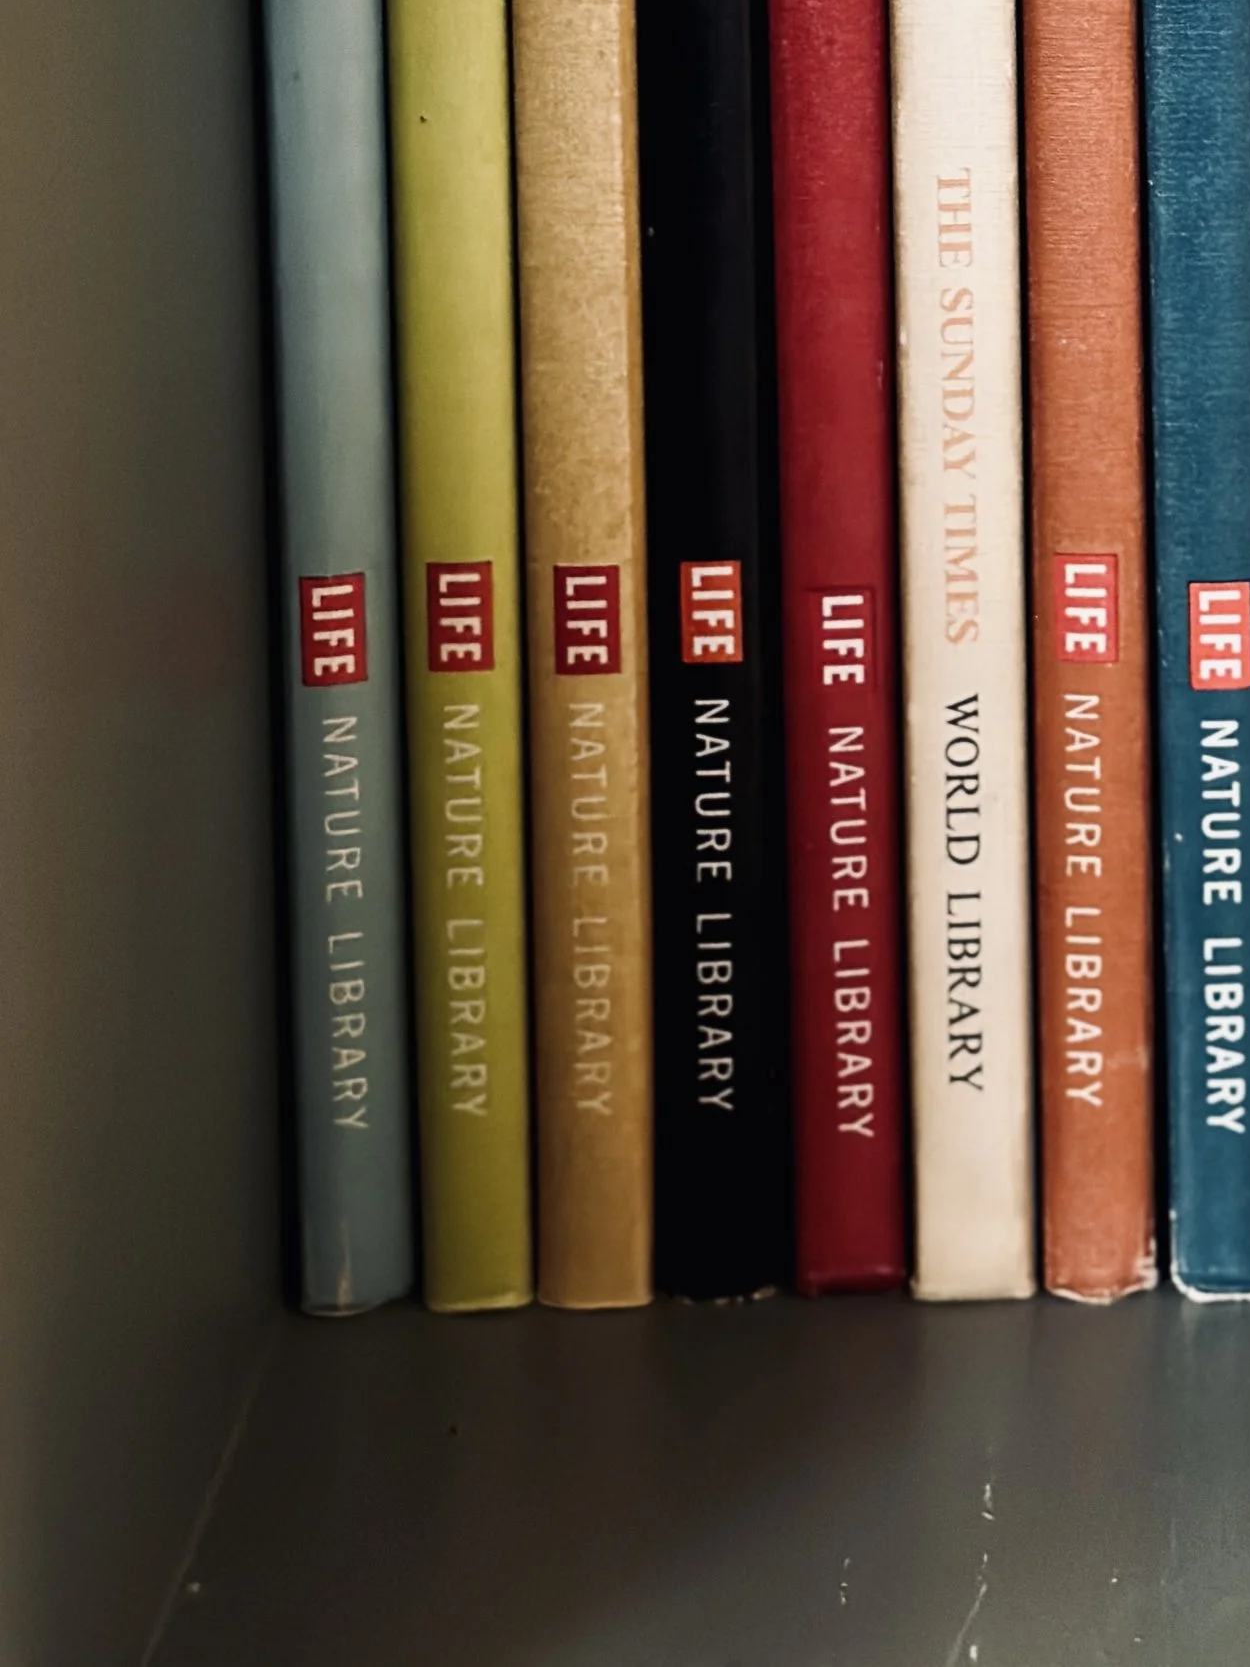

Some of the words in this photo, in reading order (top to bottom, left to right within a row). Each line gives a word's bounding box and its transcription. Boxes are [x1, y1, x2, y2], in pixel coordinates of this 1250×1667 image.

[935, 167, 973, 269] THE
[938, 284, 980, 480] SUNDAY
[310, 584, 357, 679] LIFE
[436, 572, 483, 664] LIFE
[564, 574, 609, 668] LIFE
[690, 565, 736, 658] LIFE
[820, 593, 865, 686] LIFE
[942, 495, 981, 645] TIMES
[1062, 562, 1109, 655] LIFE
[1197, 588, 1244, 682] LIFE
[319, 716, 364, 900] NATURE
[441, 704, 485, 888] NATURE
[567, 702, 608, 884] NATURE
[693, 698, 733, 882] NATURE
[827, 726, 870, 910] NATURE
[943, 693, 984, 867] WORLD
[1062, 693, 1103, 877] NATURE
[1200, 719, 1243, 906] NATURE
[326, 932, 369, 1131] LIBRARY
[445, 919, 486, 1118] LIBRARY
[569, 915, 612, 1116] LIBRARY
[696, 912, 735, 1112] LIBRARY
[833, 938, 875, 1138] LIBRARY
[946, 890, 986, 1093] LIBRARY
[1064, 906, 1104, 1109] LIBRARY
[1205, 937, 1247, 1135] LIBRARY
